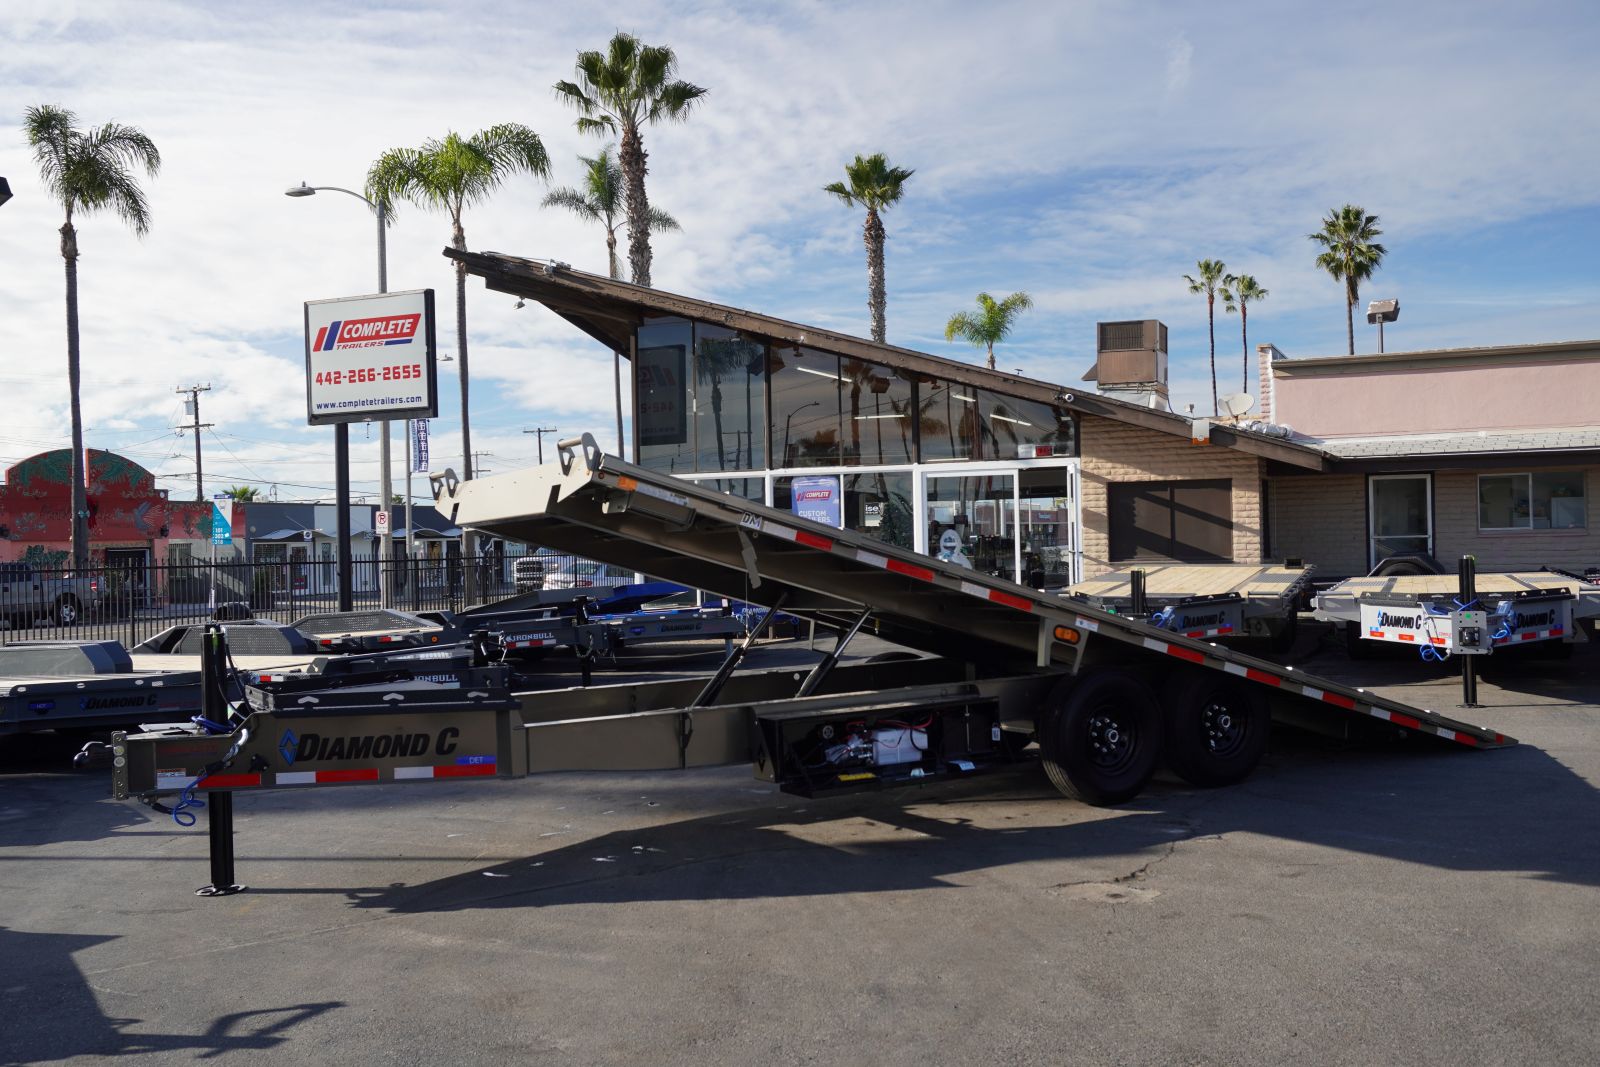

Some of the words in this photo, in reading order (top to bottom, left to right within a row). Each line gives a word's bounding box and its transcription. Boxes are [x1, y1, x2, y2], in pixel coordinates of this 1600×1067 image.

[343, 318, 414, 339] COMPLETE
[336, 340, 385, 350] TRAILERS
[315, 364, 421, 386] 442-266-2655
[316, 395, 422, 409] www.completetrailers.com
[1381, 612, 1415, 629] DIAMOND
[1416, 615, 1421, 630] C
[513, 632, 554, 641] IRONBULL
[296, 733, 430, 762] DIAMOND
[435, 727, 460, 755] C
